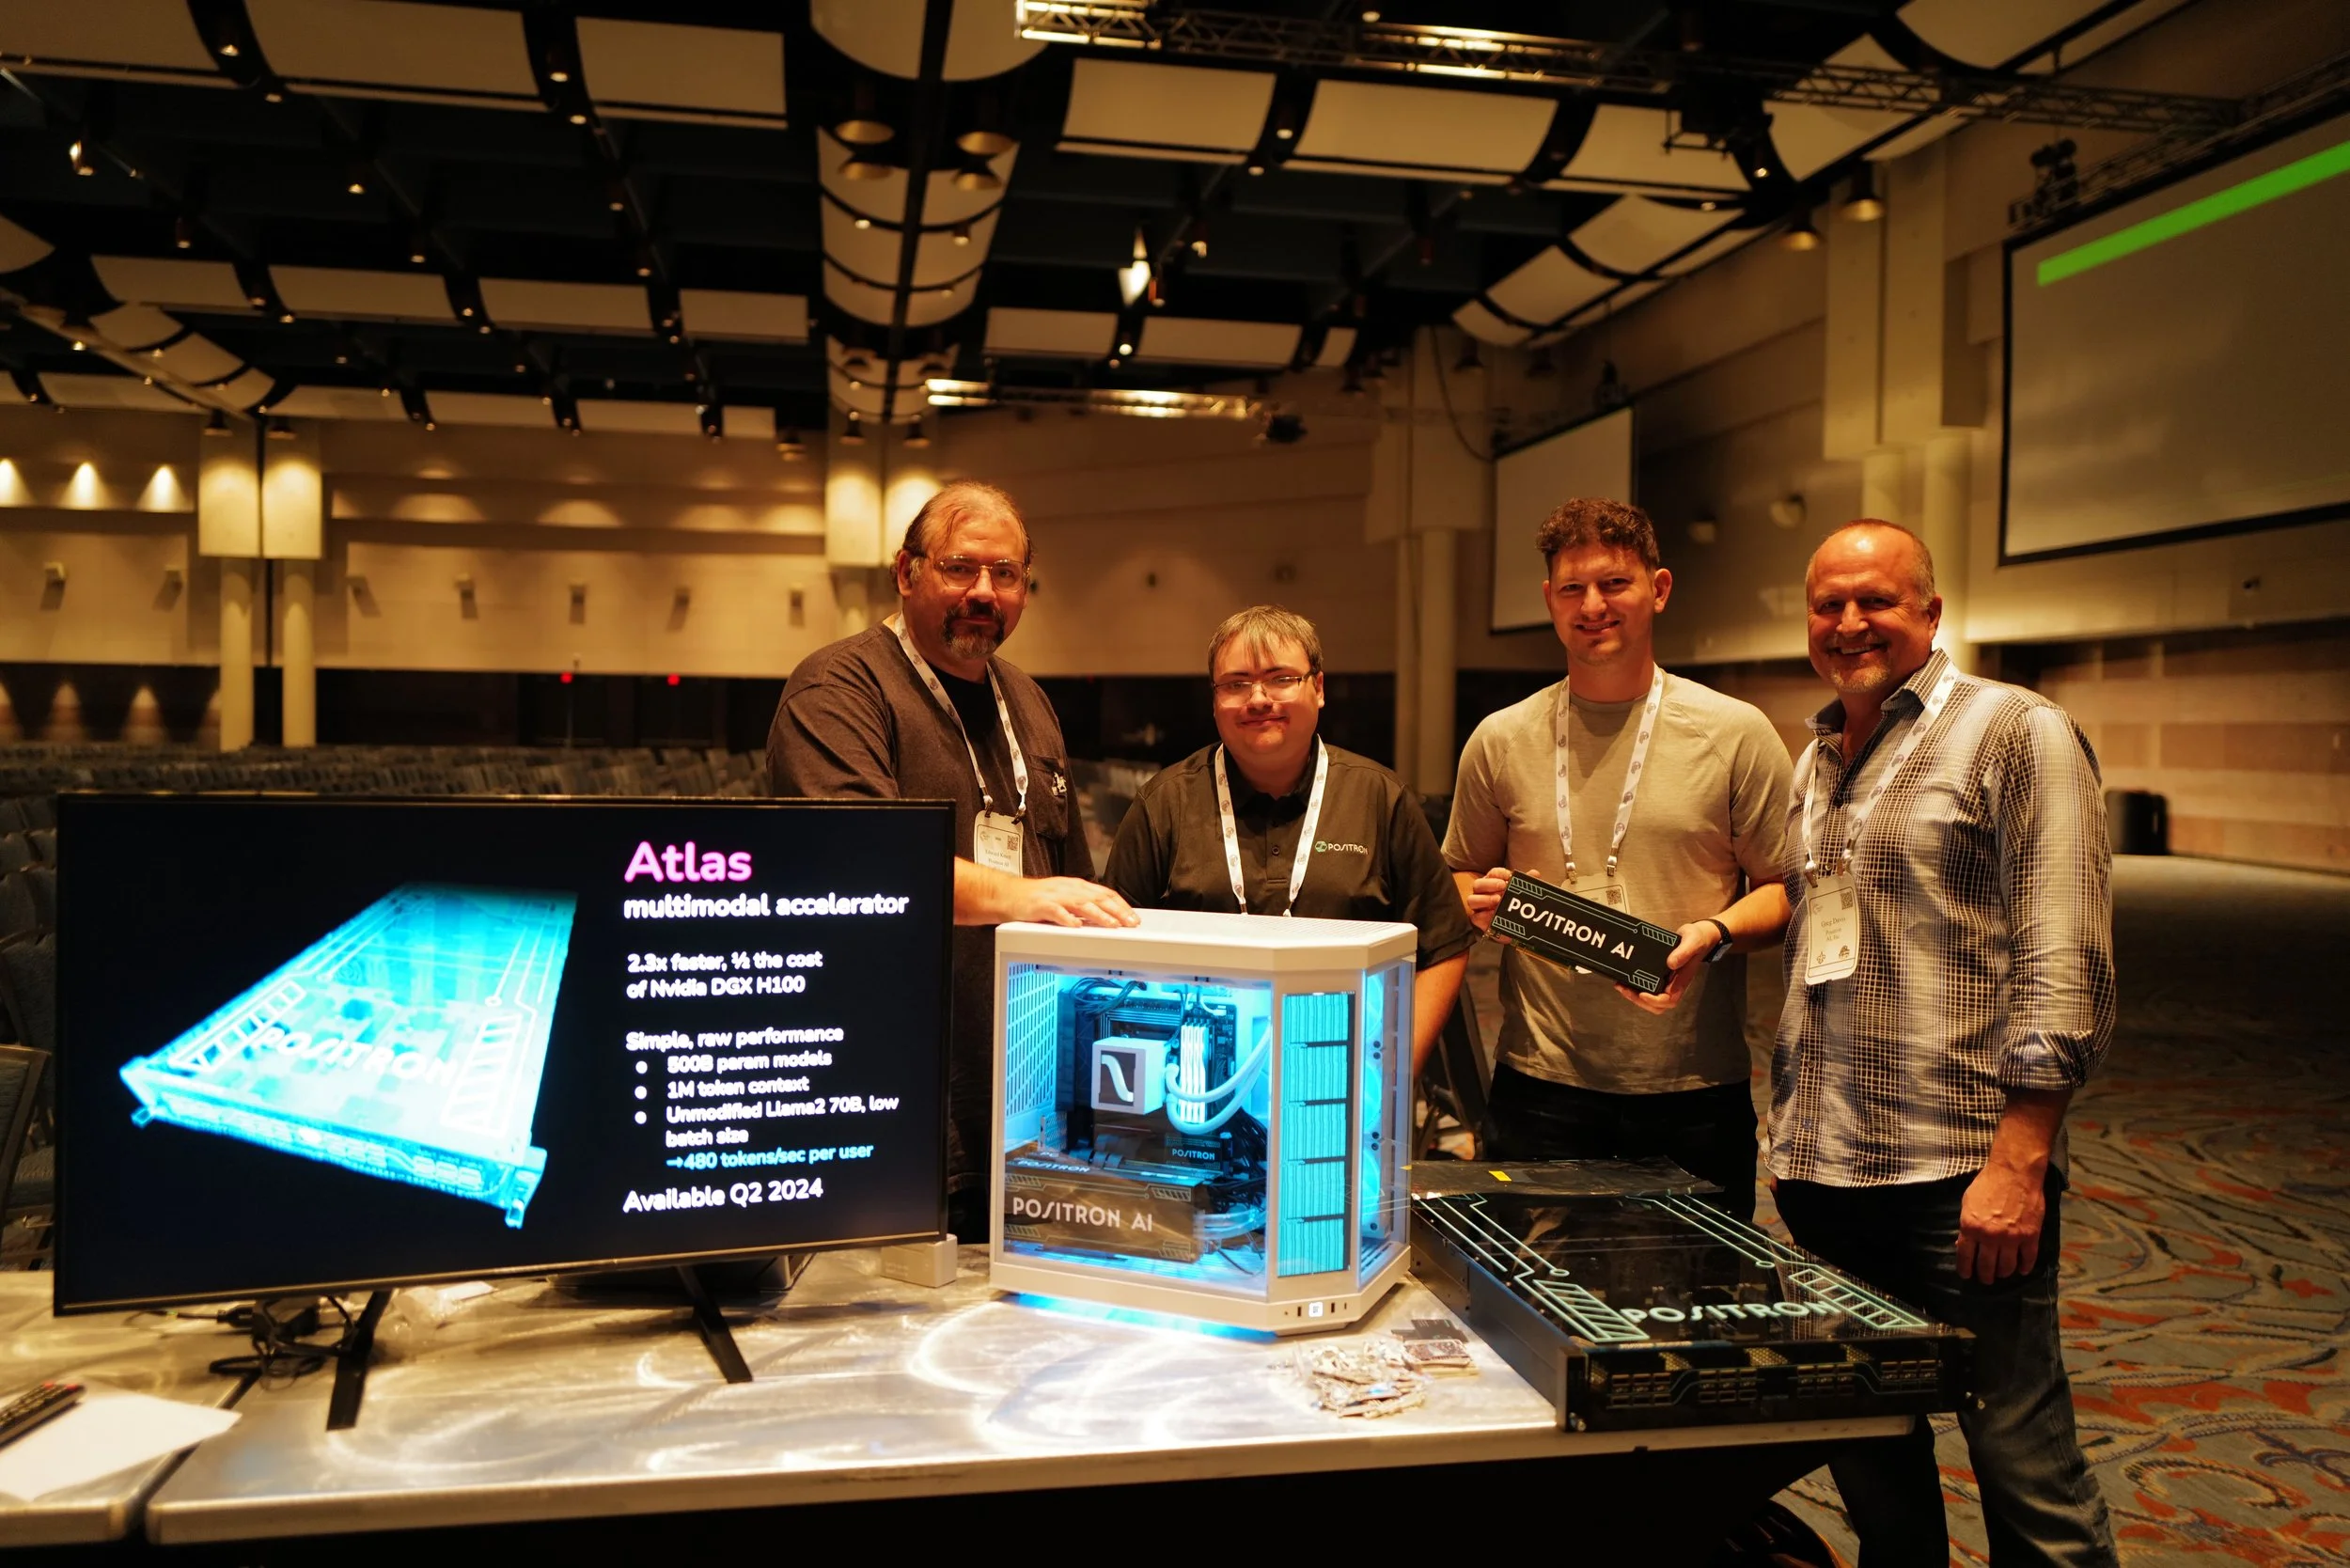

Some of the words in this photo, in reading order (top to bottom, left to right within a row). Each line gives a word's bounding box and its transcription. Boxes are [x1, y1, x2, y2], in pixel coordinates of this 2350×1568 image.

[624, 841, 752, 883] Atlas
[624, 893, 771, 918] multimodal
[776, 892, 909, 916] accelerator
[1508, 897, 1606, 949] POSITRON
[1610, 941, 1635, 960] AI
[628, 953, 667, 973] 2.3x
[670, 952, 728, 972] faster,
[753, 951, 783, 969] the
[786, 951, 822, 968] cost
[626, 980, 648, 998] of
[650, 978, 707, 998] Nvidia
[711, 977, 753, 996] DGX
[757, 975, 806, 994] H100
[626, 1030, 694, 1053] Simple,
[697, 1032, 732, 1047] raw
[735, 1027, 844, 1050] performance
[717, 1056, 770, 1074] param
[773, 1050, 832, 1068] models
[667, 1080, 695, 1099] 1M
[697, 1079, 745, 1097] token
[747, 1075, 809, 1094] context
[666, 1102, 762, 1123] Unmodified
[765, 1098, 825, 1118] Llama2
[829, 1096, 866, 1113] 70B,
[869, 1095, 899, 1111] low
[666, 1127, 713, 1148] batch
[716, 1127, 749, 1145] size
[720, 1147, 806, 1168] tokens/sec
[808, 1148, 837, 1165] per
[838, 1145, 874, 1159] user
[1172, 1148, 1215, 1160] POSITRON
[622, 1186, 726, 1213] Available
[729, 1182, 762, 1208] Q2
[768, 1178, 823, 1201] 2024
[1012, 1197, 1120, 1228] POSITRON
[1131, 1212, 1153, 1232] AI
[1620, 1300, 1841, 1324] POSITRON
